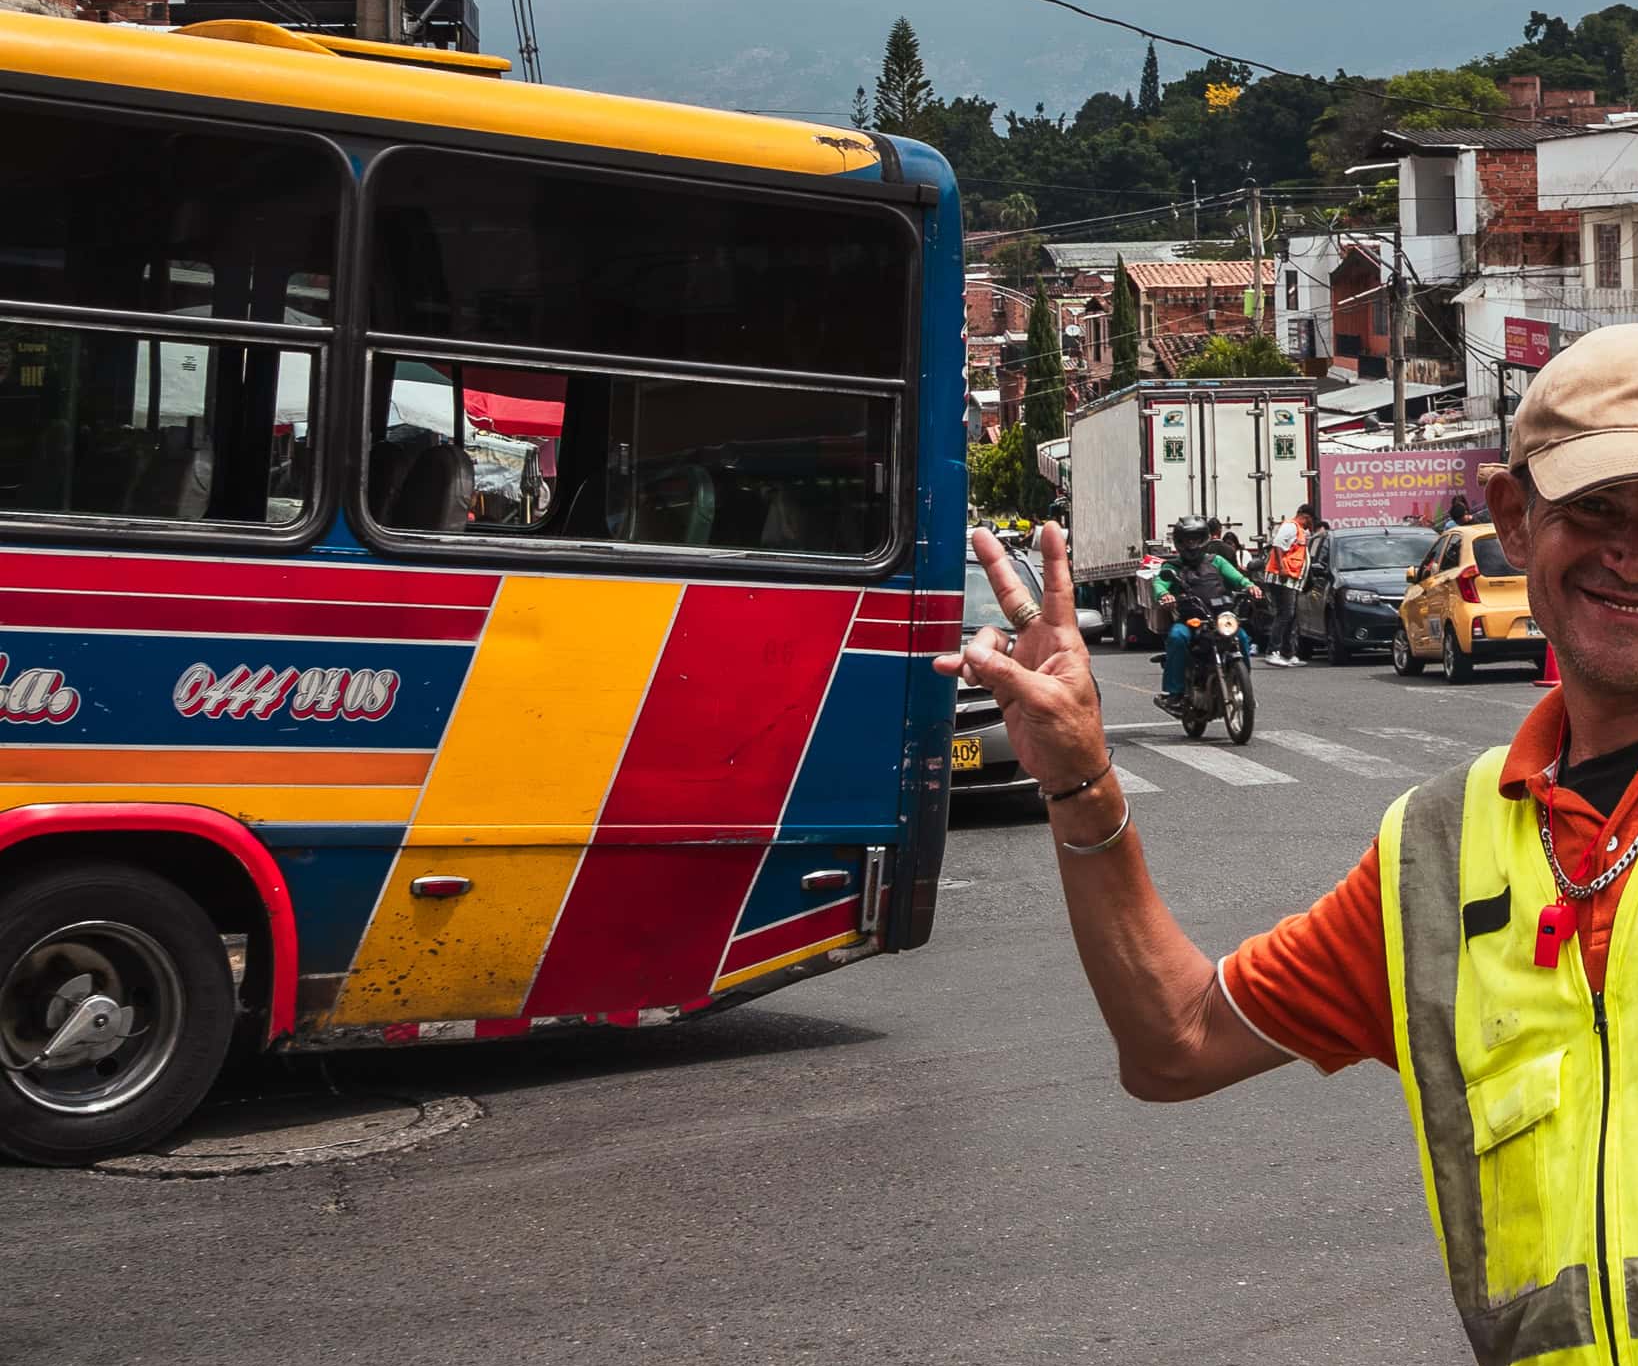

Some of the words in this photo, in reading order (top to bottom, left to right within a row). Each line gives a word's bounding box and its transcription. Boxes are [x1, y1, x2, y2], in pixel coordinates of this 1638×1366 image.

[1334, 458, 1466, 475] AUTOSERVICIO
[1335, 476, 1374, 491] LOS
[1382, 473, 1465, 490] MOMPIS
[1336, 500, 1364, 508] SINCE
